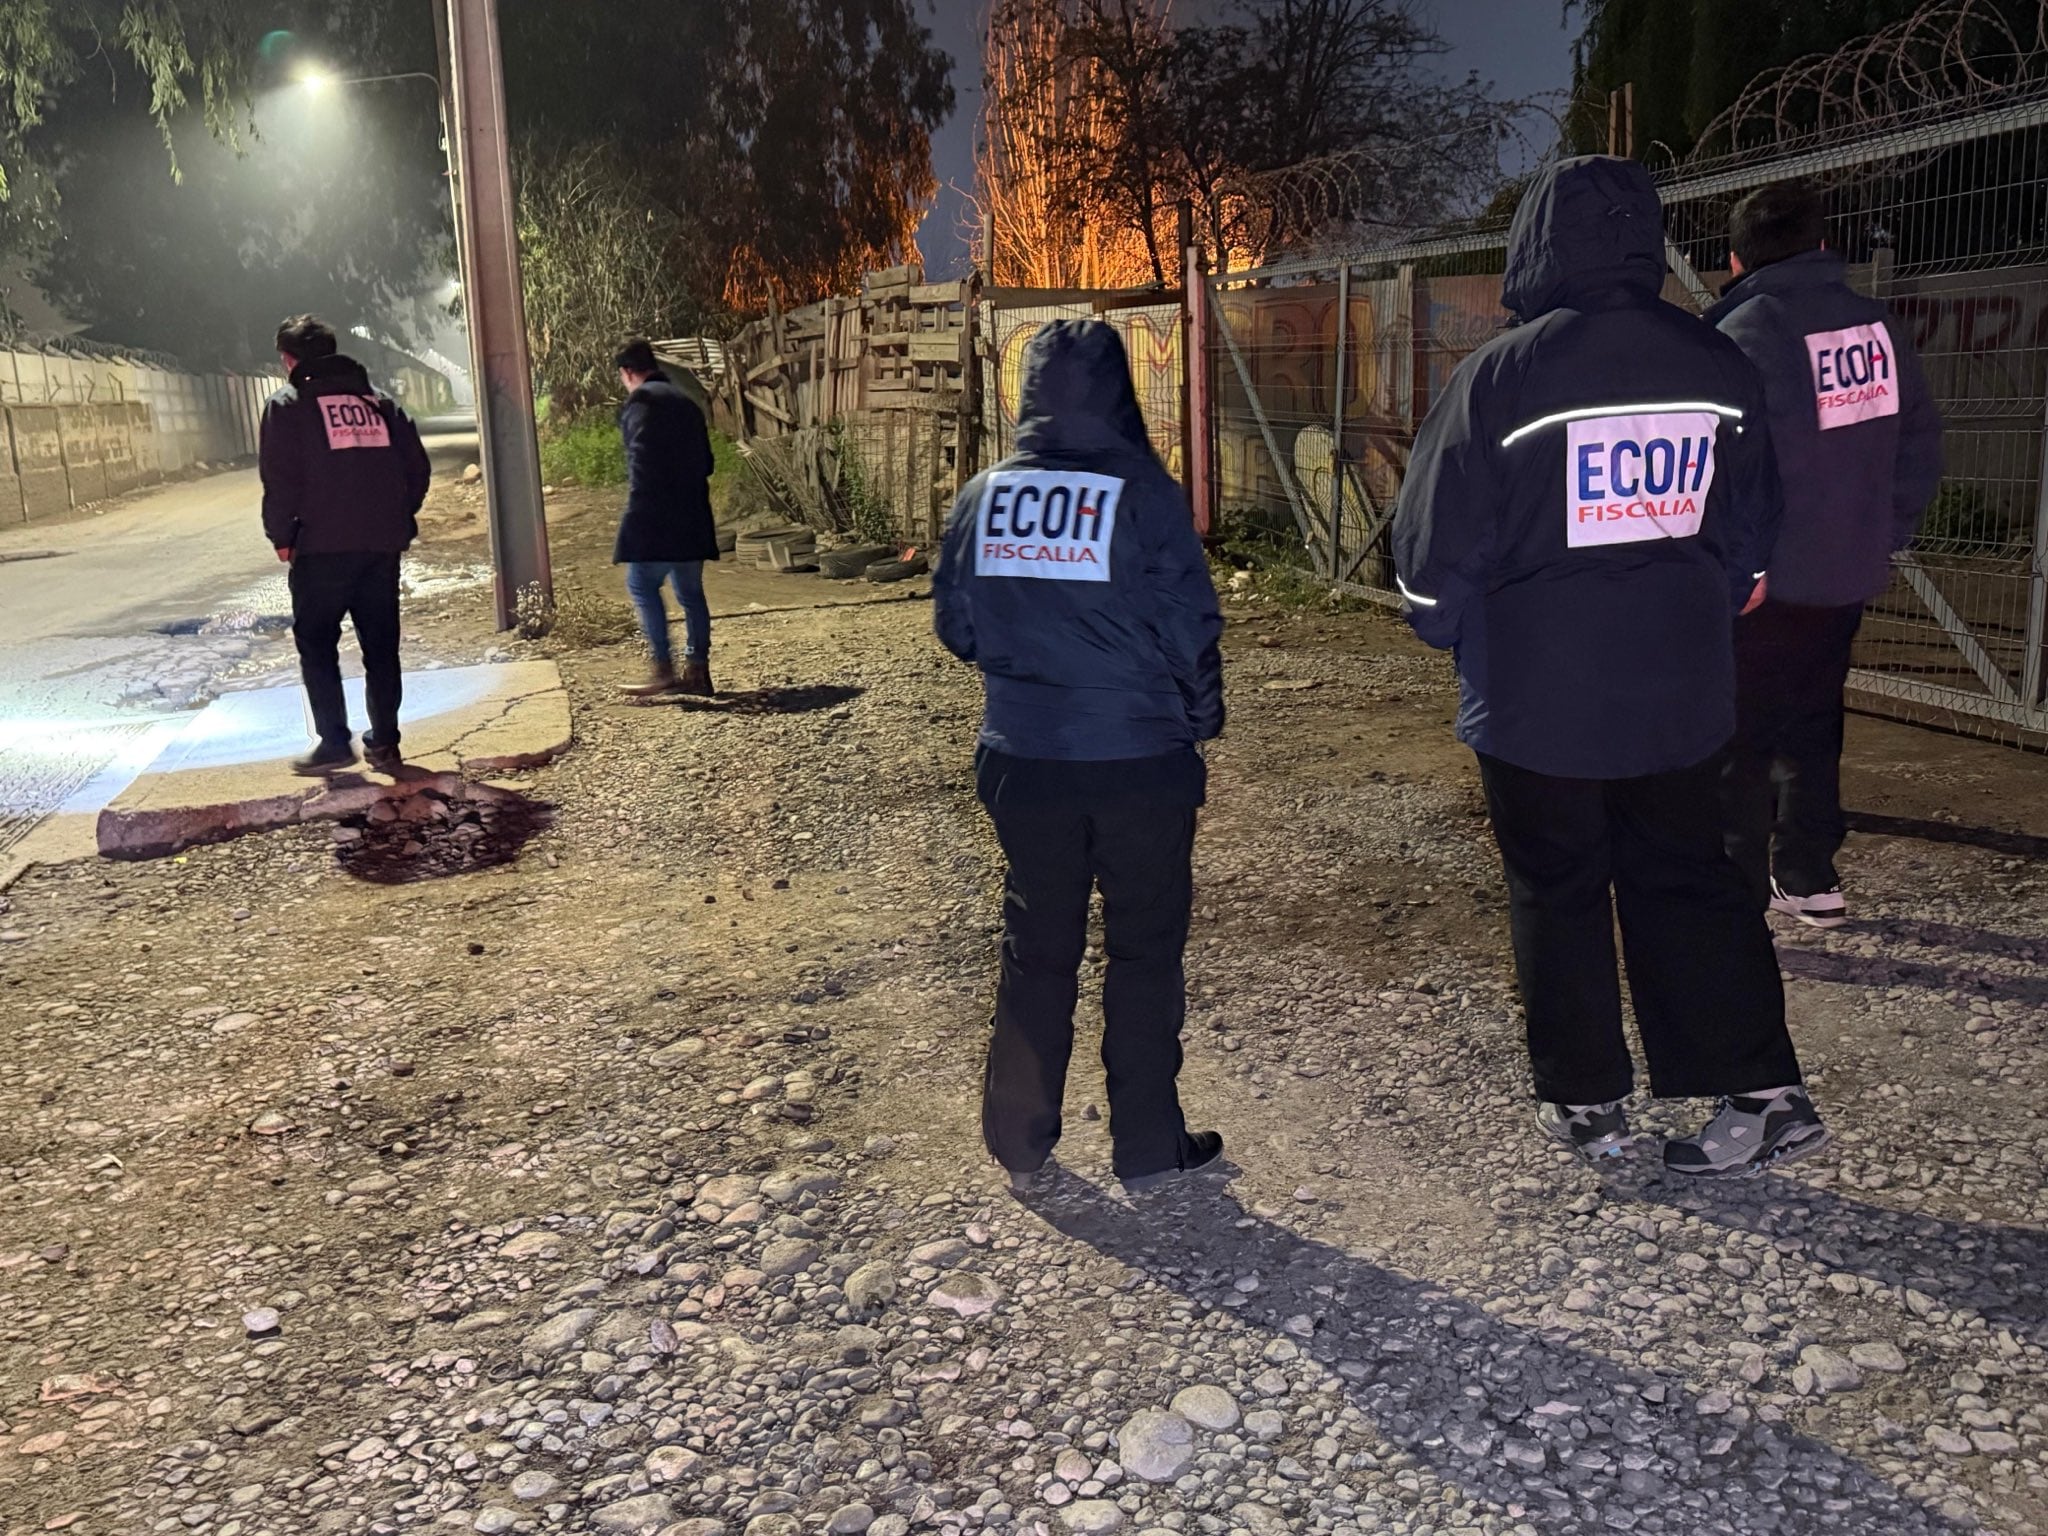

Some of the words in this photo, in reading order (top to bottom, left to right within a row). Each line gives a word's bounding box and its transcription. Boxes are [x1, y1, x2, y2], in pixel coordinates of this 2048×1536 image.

[1818, 340, 1888, 393] ECOH
[1818, 384, 1888, 409] FISCALIA
[326, 404, 380, 428] ECOH
[1578, 436, 1709, 501] ECOH
[986, 485, 1109, 541] ECOH
[1578, 498, 1696, 523] FISCALIA
[983, 543, 1099, 563] FISCALIA
